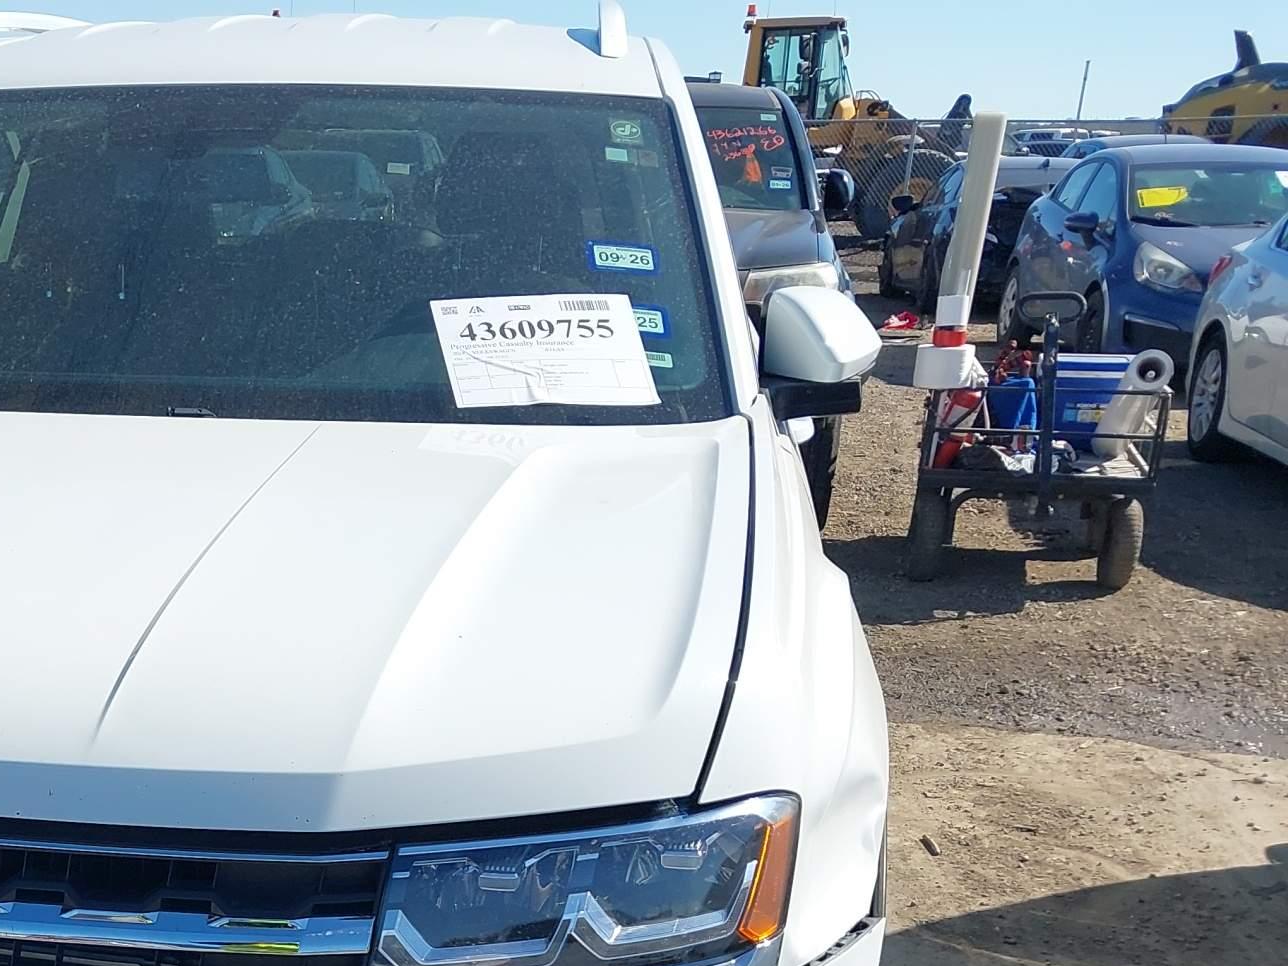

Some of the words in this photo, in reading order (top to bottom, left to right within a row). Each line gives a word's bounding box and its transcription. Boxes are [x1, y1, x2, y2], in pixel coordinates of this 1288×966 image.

[598, 251, 620, 263] 09
[629, 254, 650, 266] 26
[459, 319, 614, 341] 43609755
[637, 316, 659, 329] 25
